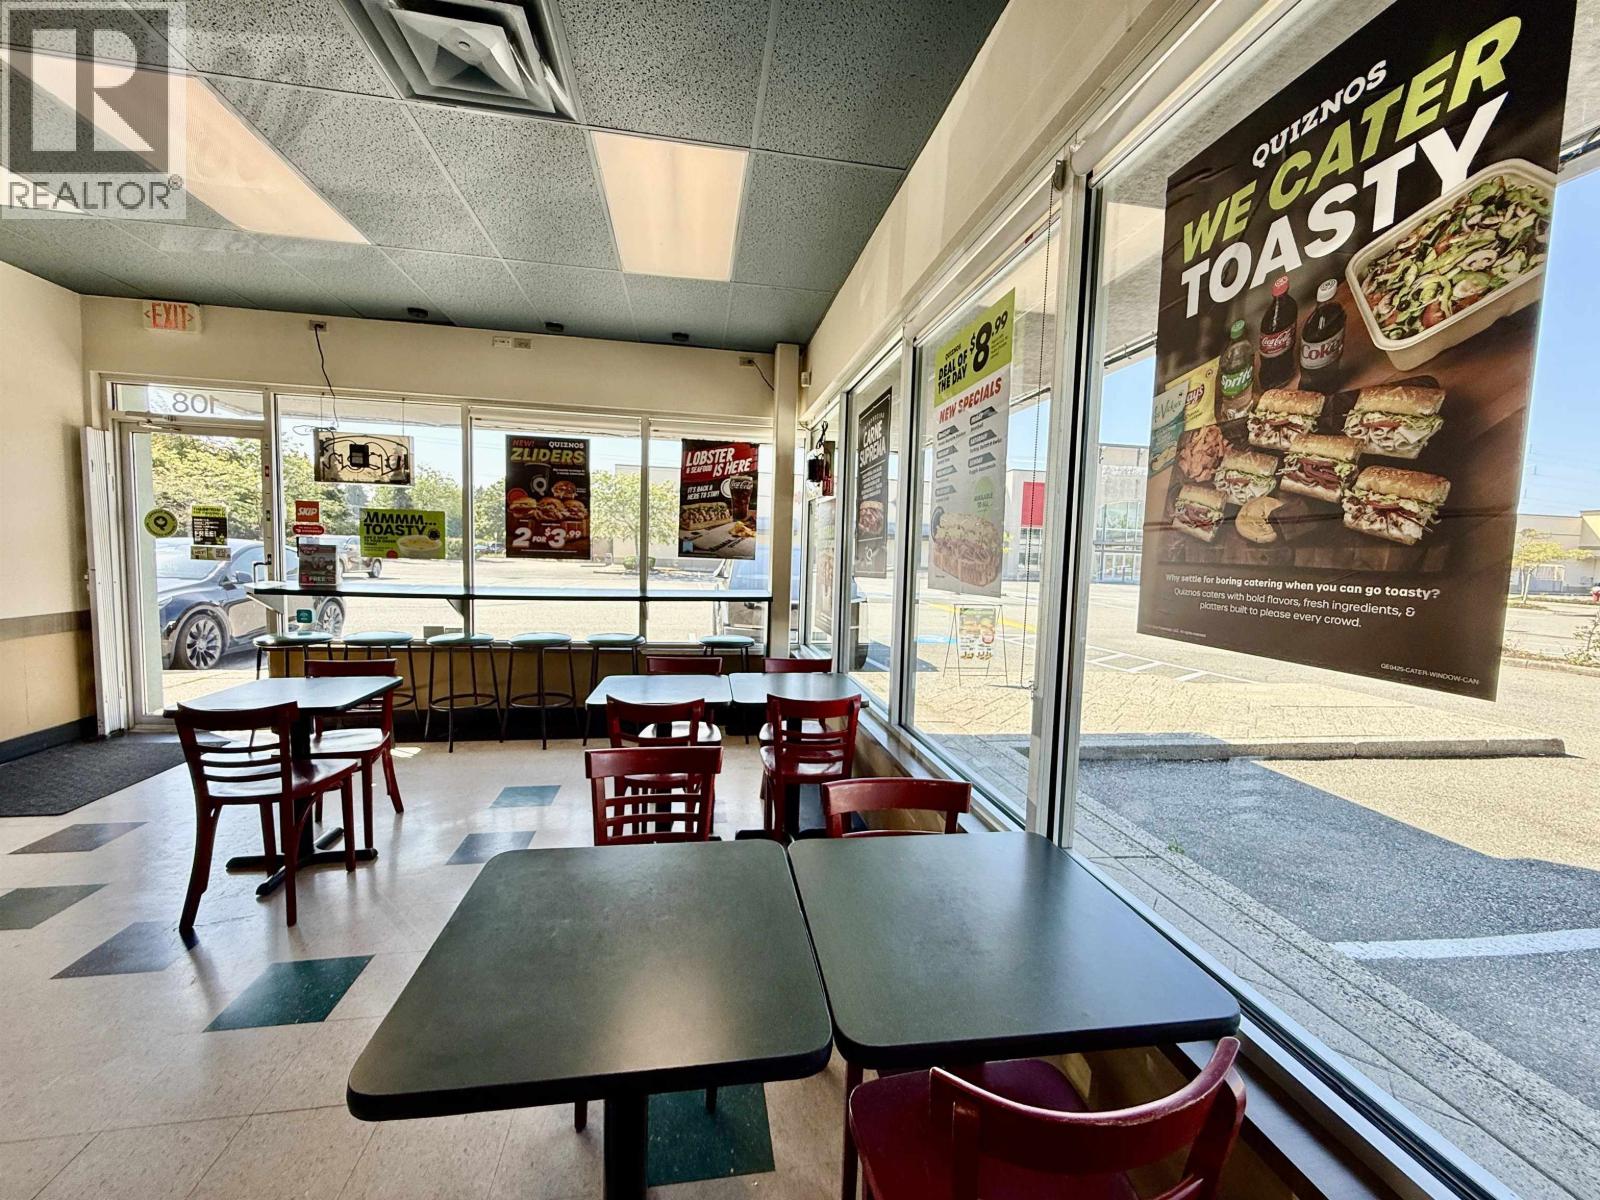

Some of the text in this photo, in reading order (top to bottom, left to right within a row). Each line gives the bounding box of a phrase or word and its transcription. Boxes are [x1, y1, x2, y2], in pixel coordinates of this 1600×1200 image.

[1252, 59, 1387, 168] QUIZNOS
[1182, 16, 1522, 263] WE CATER
[1181, 92, 1508, 319] TOASTY
[151, 302, 188, 331] EXIT
[969, 310, 1008, 373] $8.99
[938, 350, 968, 381] DEAL OF
[938, 364, 967, 395] THE DAY
[939, 376, 1002, 424] NEW SPECIALS
[512, 439, 535, 447] NEW!
[548, 441, 584, 449] QUIZNOS
[863, 420, 883, 448] CARNE
[510, 447, 586, 465] ZLIDERS
[685, 448, 736, 467] LOBSTER
[690, 464, 713, 474] SEAFOOD
[712, 463, 724, 478] IS
[724, 457, 753, 476] HERE
[297, 507, 318, 516] SKIP
[363, 511, 437, 526] MMMM...
[363, 523, 427, 536] TOASTY
[512, 527, 582, 549] 2 FOR $3.99
[1166, 573, 1440, 600] Why settle for boring catering when you can go toasty?
[1174, 587, 1415, 617] Quiznos caters with bold flavors, fresh ingredients, &
[1200, 601, 1362, 628] platters built to please every crowd.
